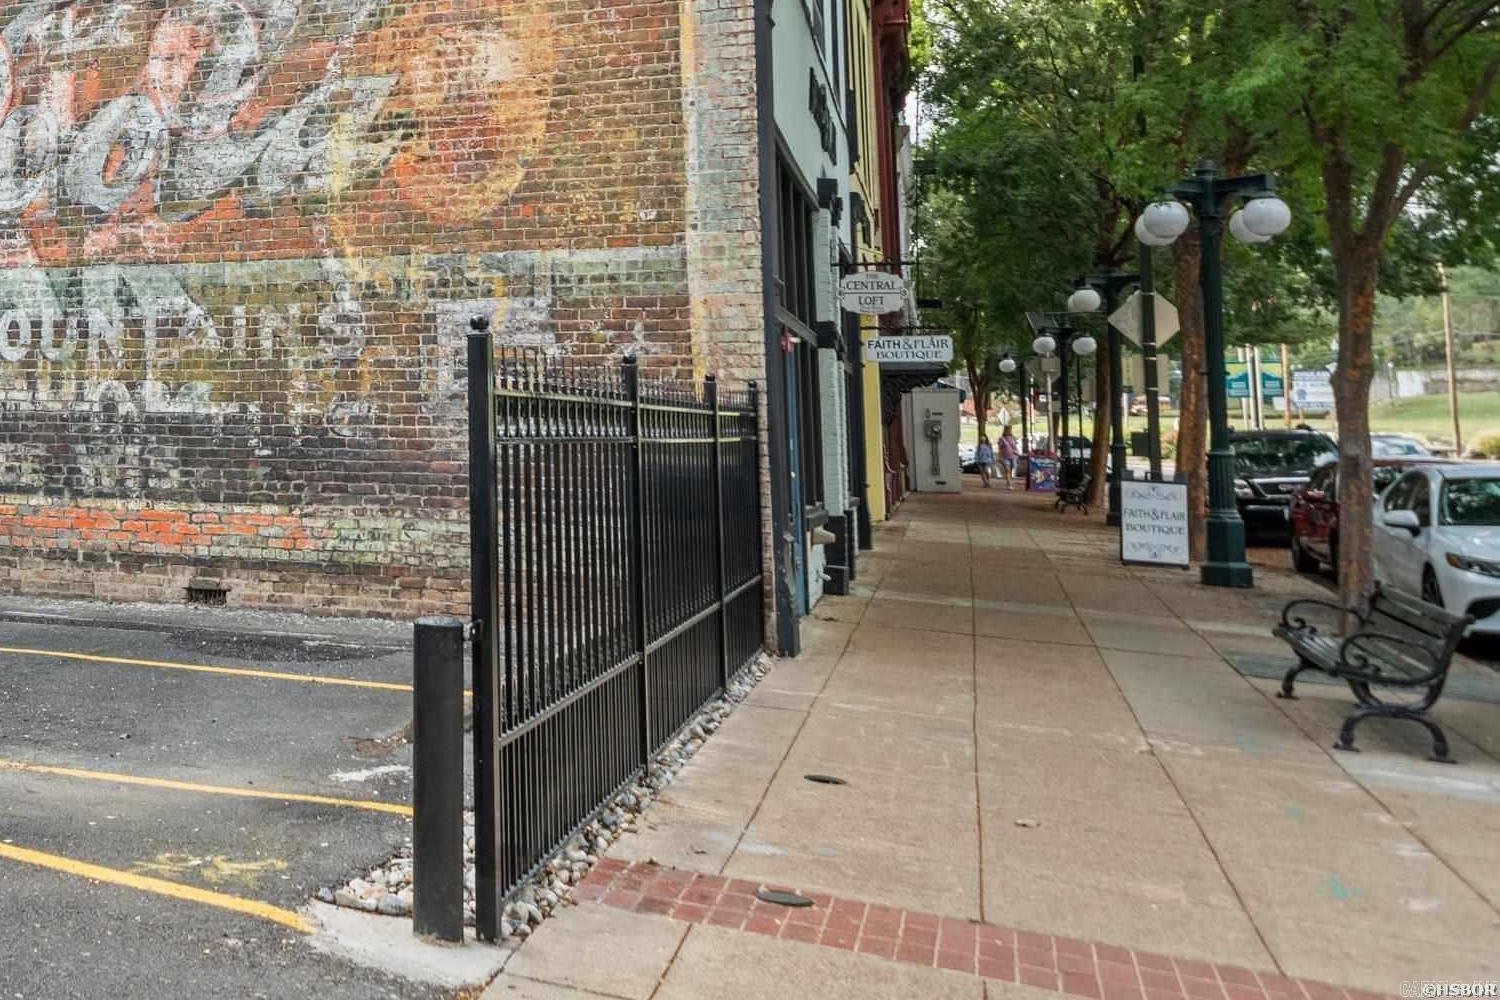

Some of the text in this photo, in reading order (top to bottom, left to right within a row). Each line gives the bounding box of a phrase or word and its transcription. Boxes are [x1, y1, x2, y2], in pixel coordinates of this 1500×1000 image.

[845, 281, 897, 290] CENTRAL
[858, 296, 885, 305] LOFT
[867, 340, 900, 349] FAITH
[914, 338, 949, 349] FLAIR
[876, 350, 943, 360] BOUTIQUE
[1125, 522, 1187, 536] BOUTIQUE
